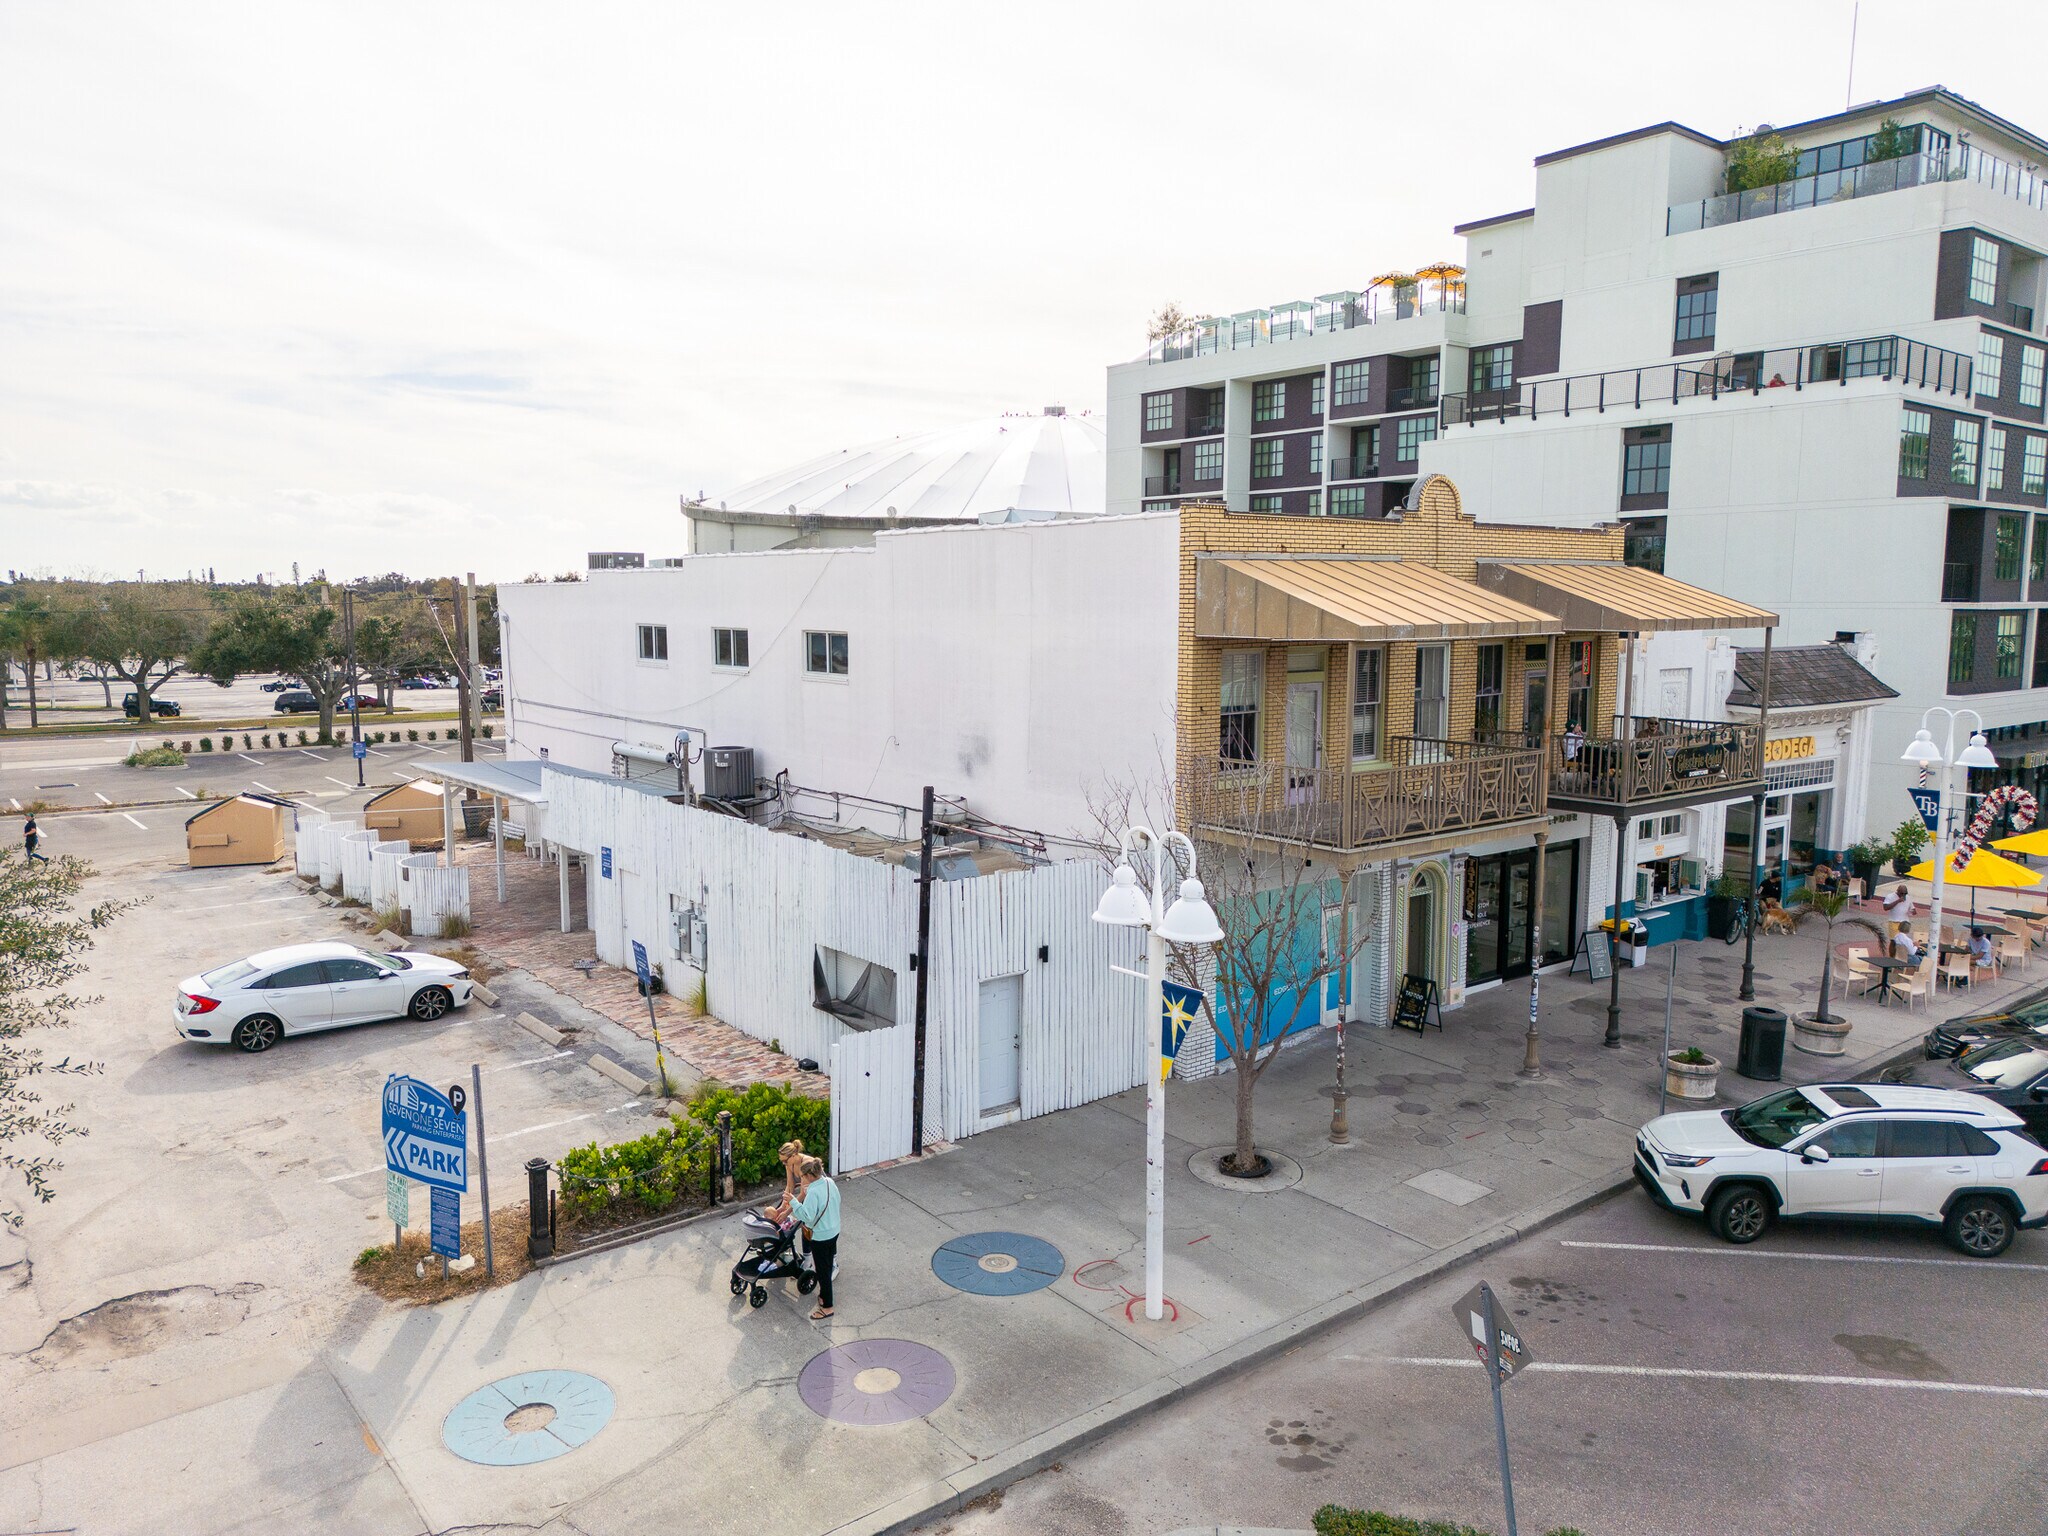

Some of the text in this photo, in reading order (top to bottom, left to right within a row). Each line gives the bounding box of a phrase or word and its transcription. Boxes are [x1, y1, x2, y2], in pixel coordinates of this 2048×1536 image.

[1764, 736, 1815, 762] BODEGA
[453, 1090, 463, 1107] P
[419, 1101, 446, 1118] 717
[412, 1123, 465, 1142] PARKING ENTERPRISES
[410, 1143, 462, 1177] PARK
